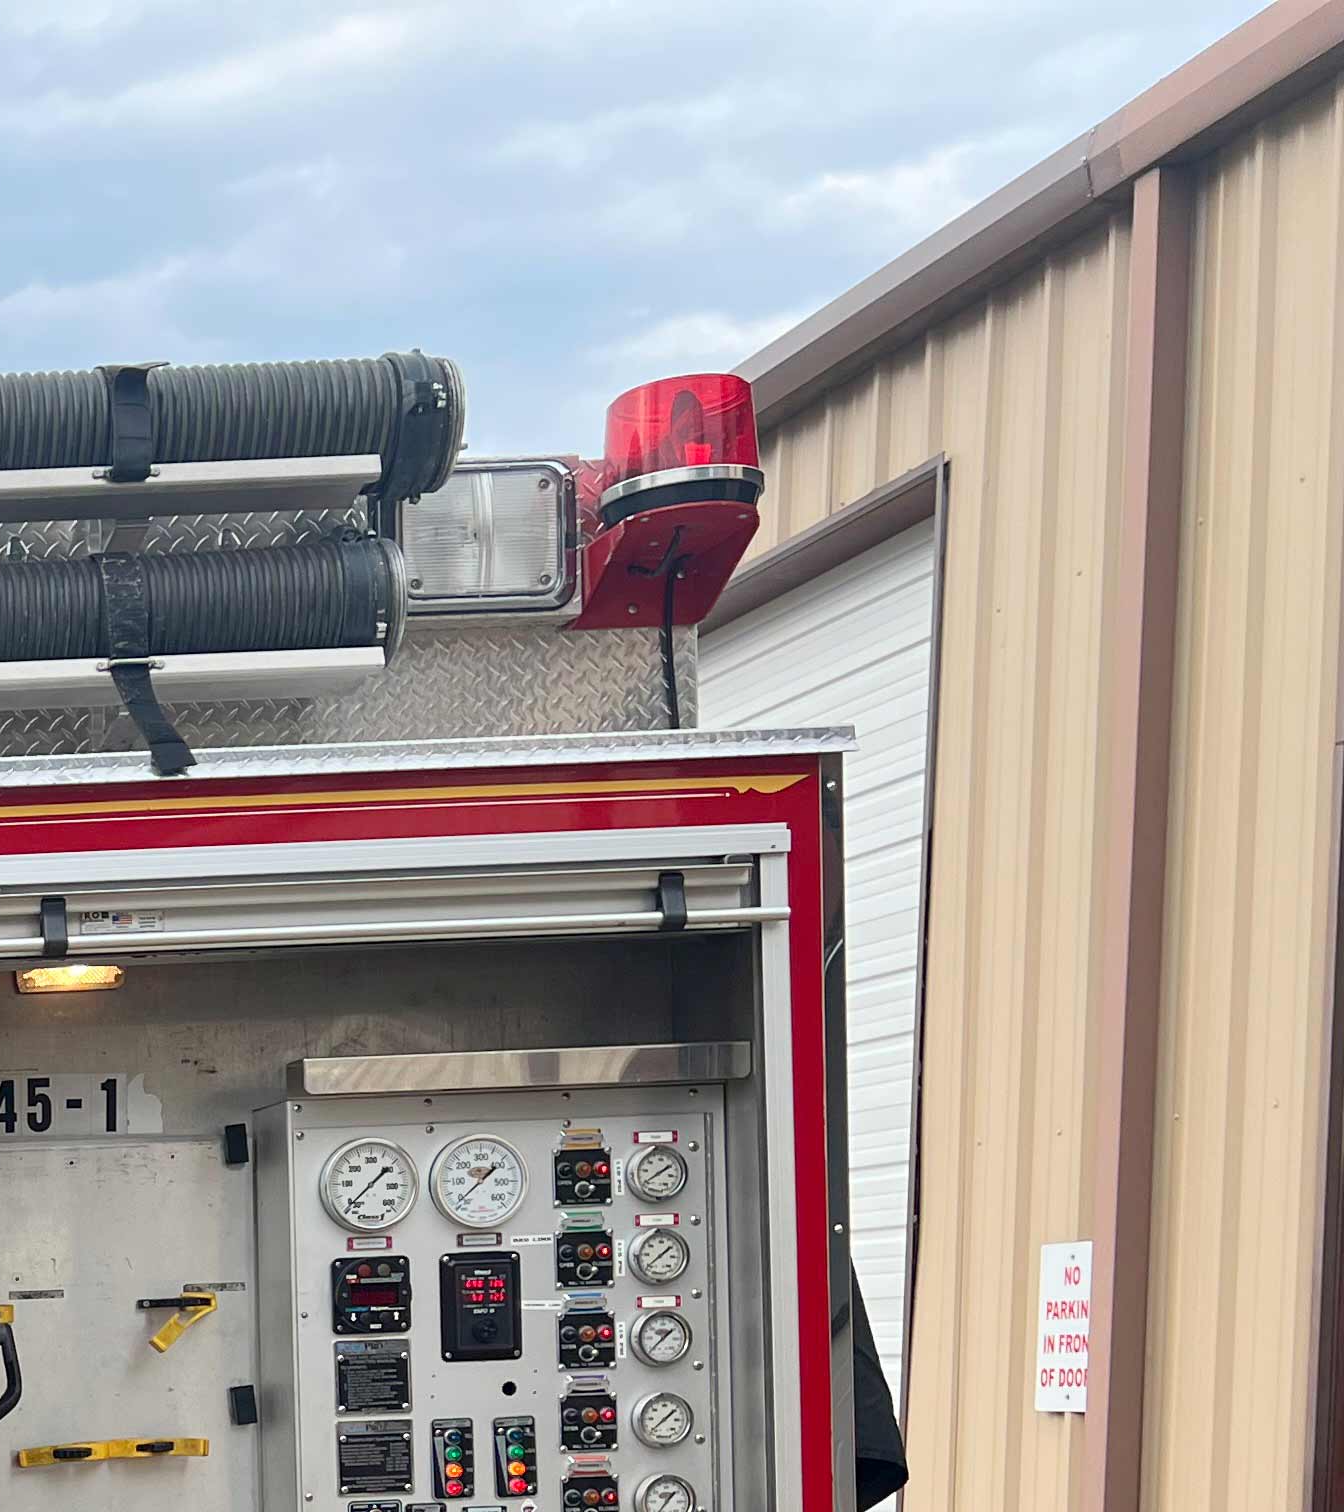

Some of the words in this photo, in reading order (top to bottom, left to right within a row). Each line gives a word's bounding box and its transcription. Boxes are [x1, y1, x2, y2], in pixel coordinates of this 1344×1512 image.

[494, 1178, 508, 1186] 500
[1064, 1266, 1080, 1285] NO
[1046, 1300, 1088, 1320] PARKIN
[1044, 1334, 1054, 1354] IN
[1059, 1333, 1088, 1354] FRON
[1041, 1368, 1055, 1387] OF
